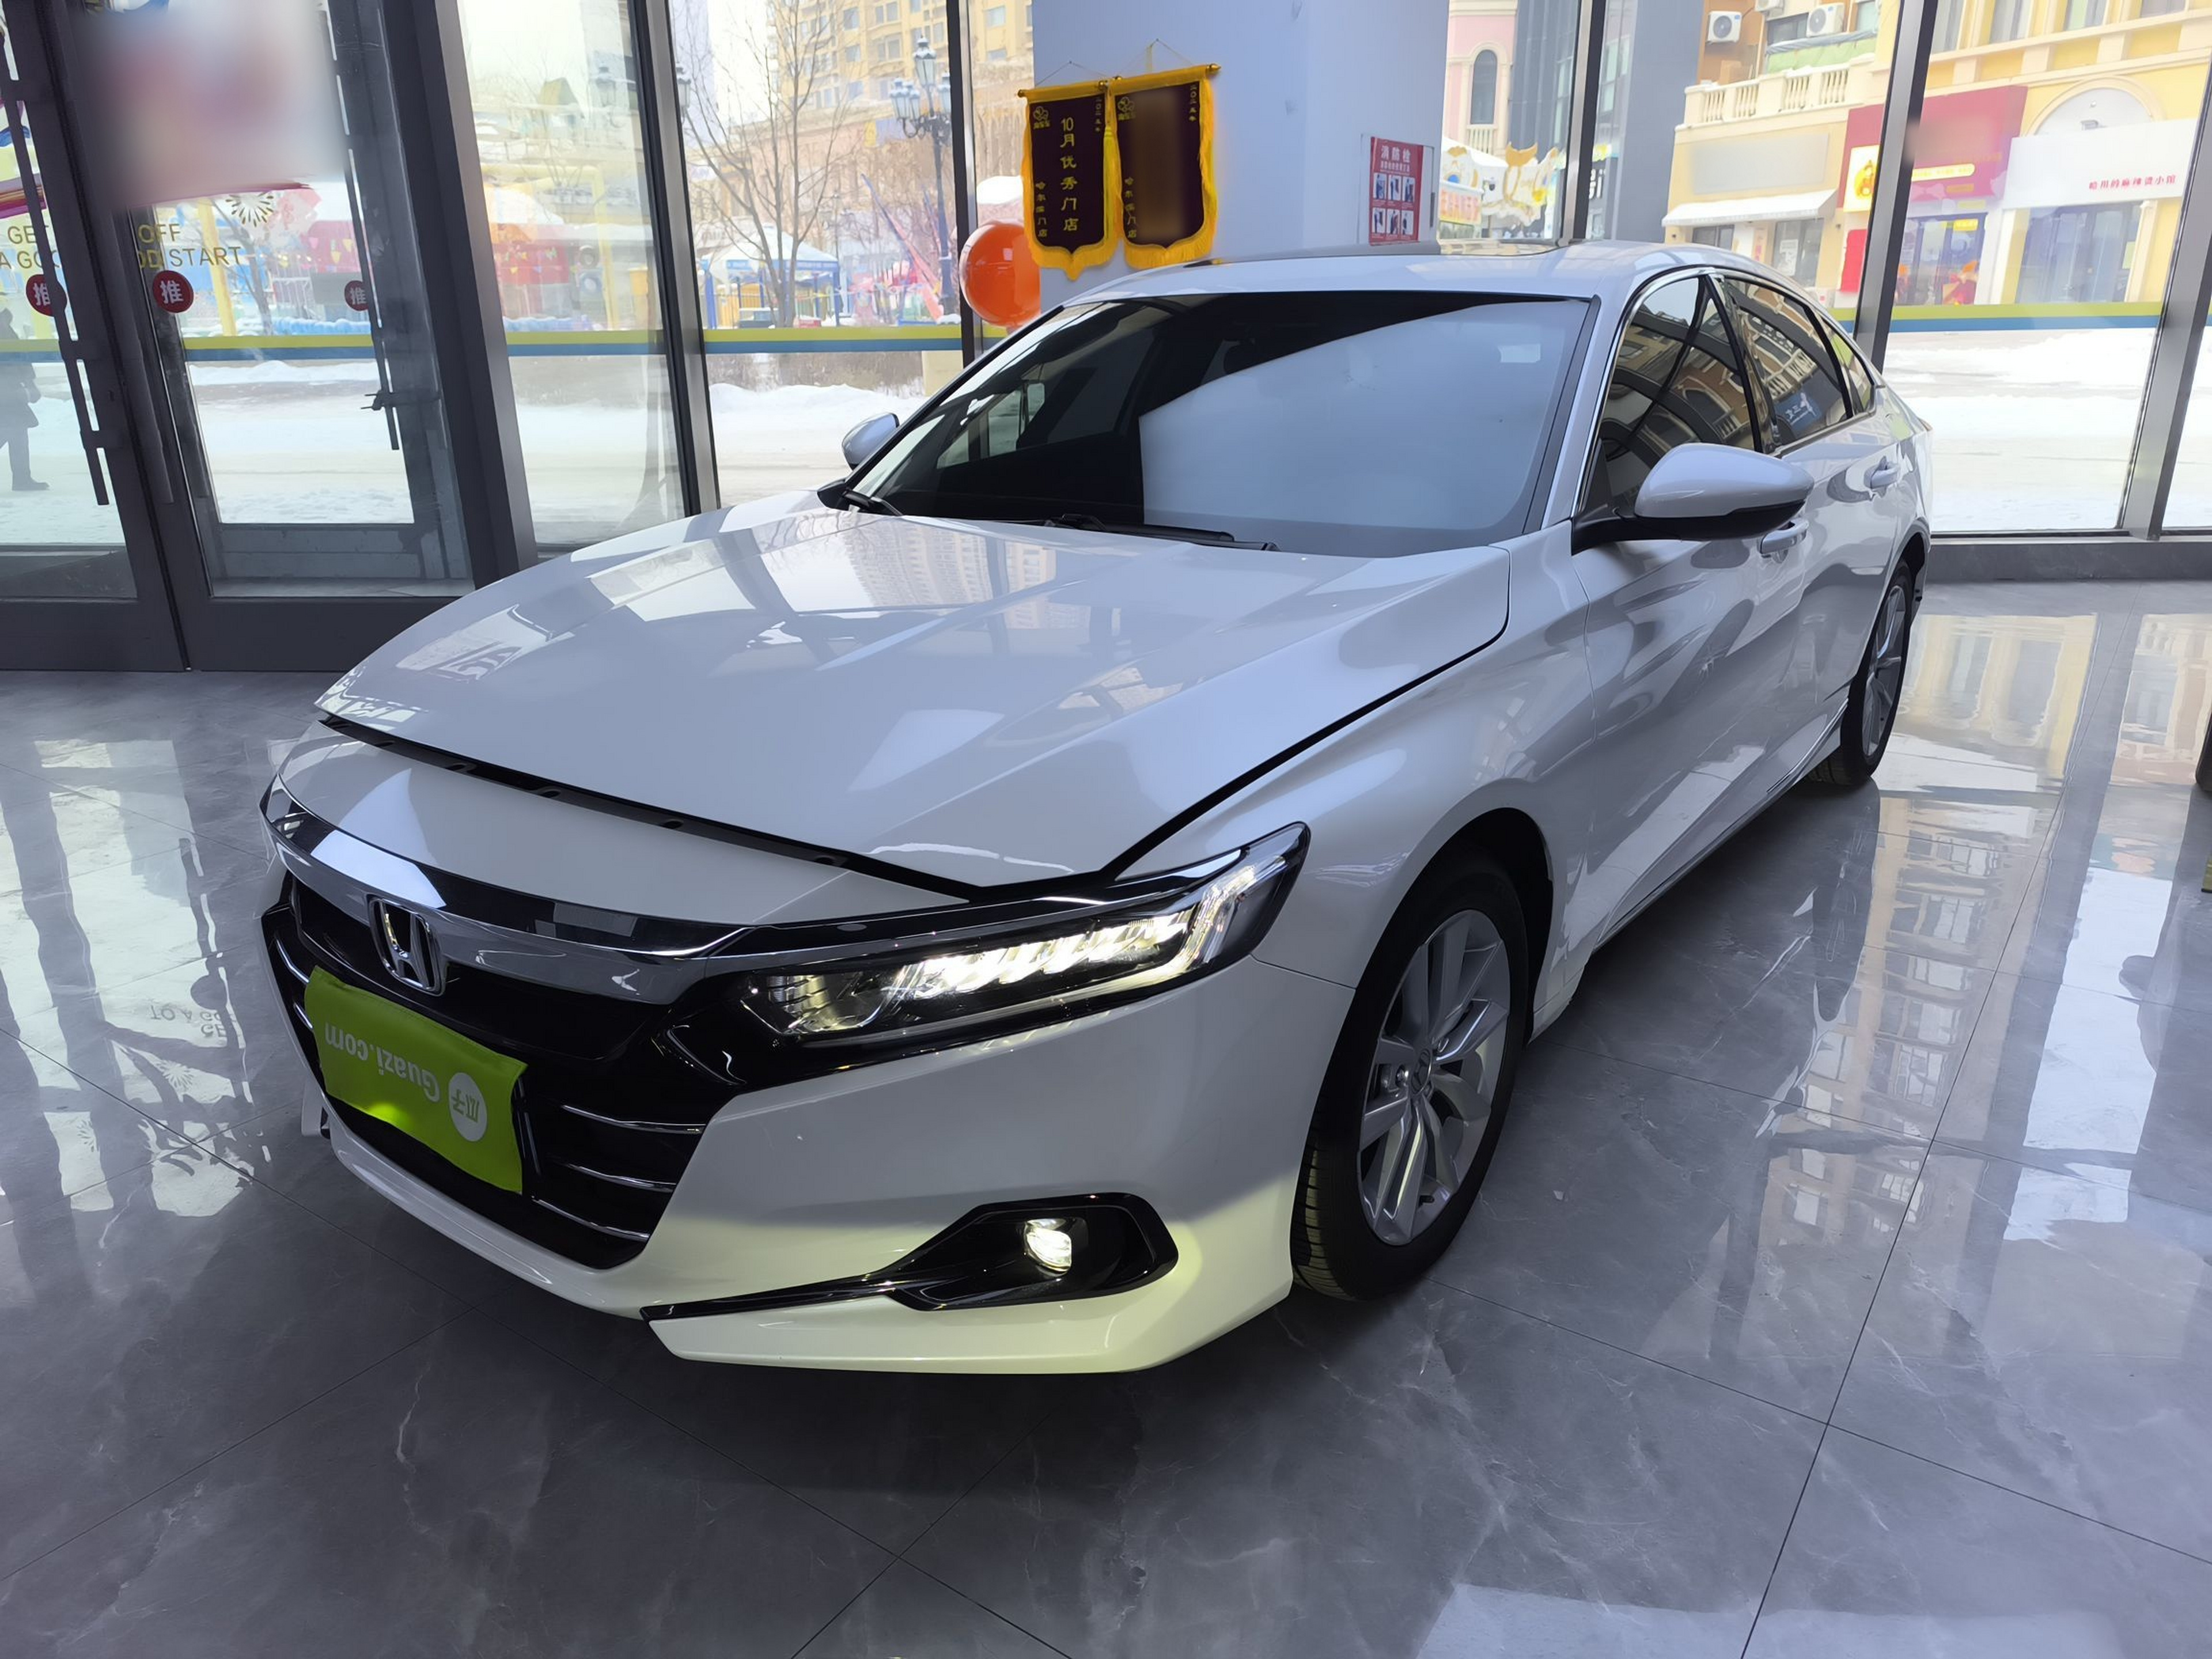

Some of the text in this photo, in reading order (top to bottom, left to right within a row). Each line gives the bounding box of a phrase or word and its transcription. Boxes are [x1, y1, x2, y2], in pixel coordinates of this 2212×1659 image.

[169, 247, 241, 267] START
[160, 280, 184, 304] 推
[324, 1022, 479, 1123] 瓜子 Guazi.com
